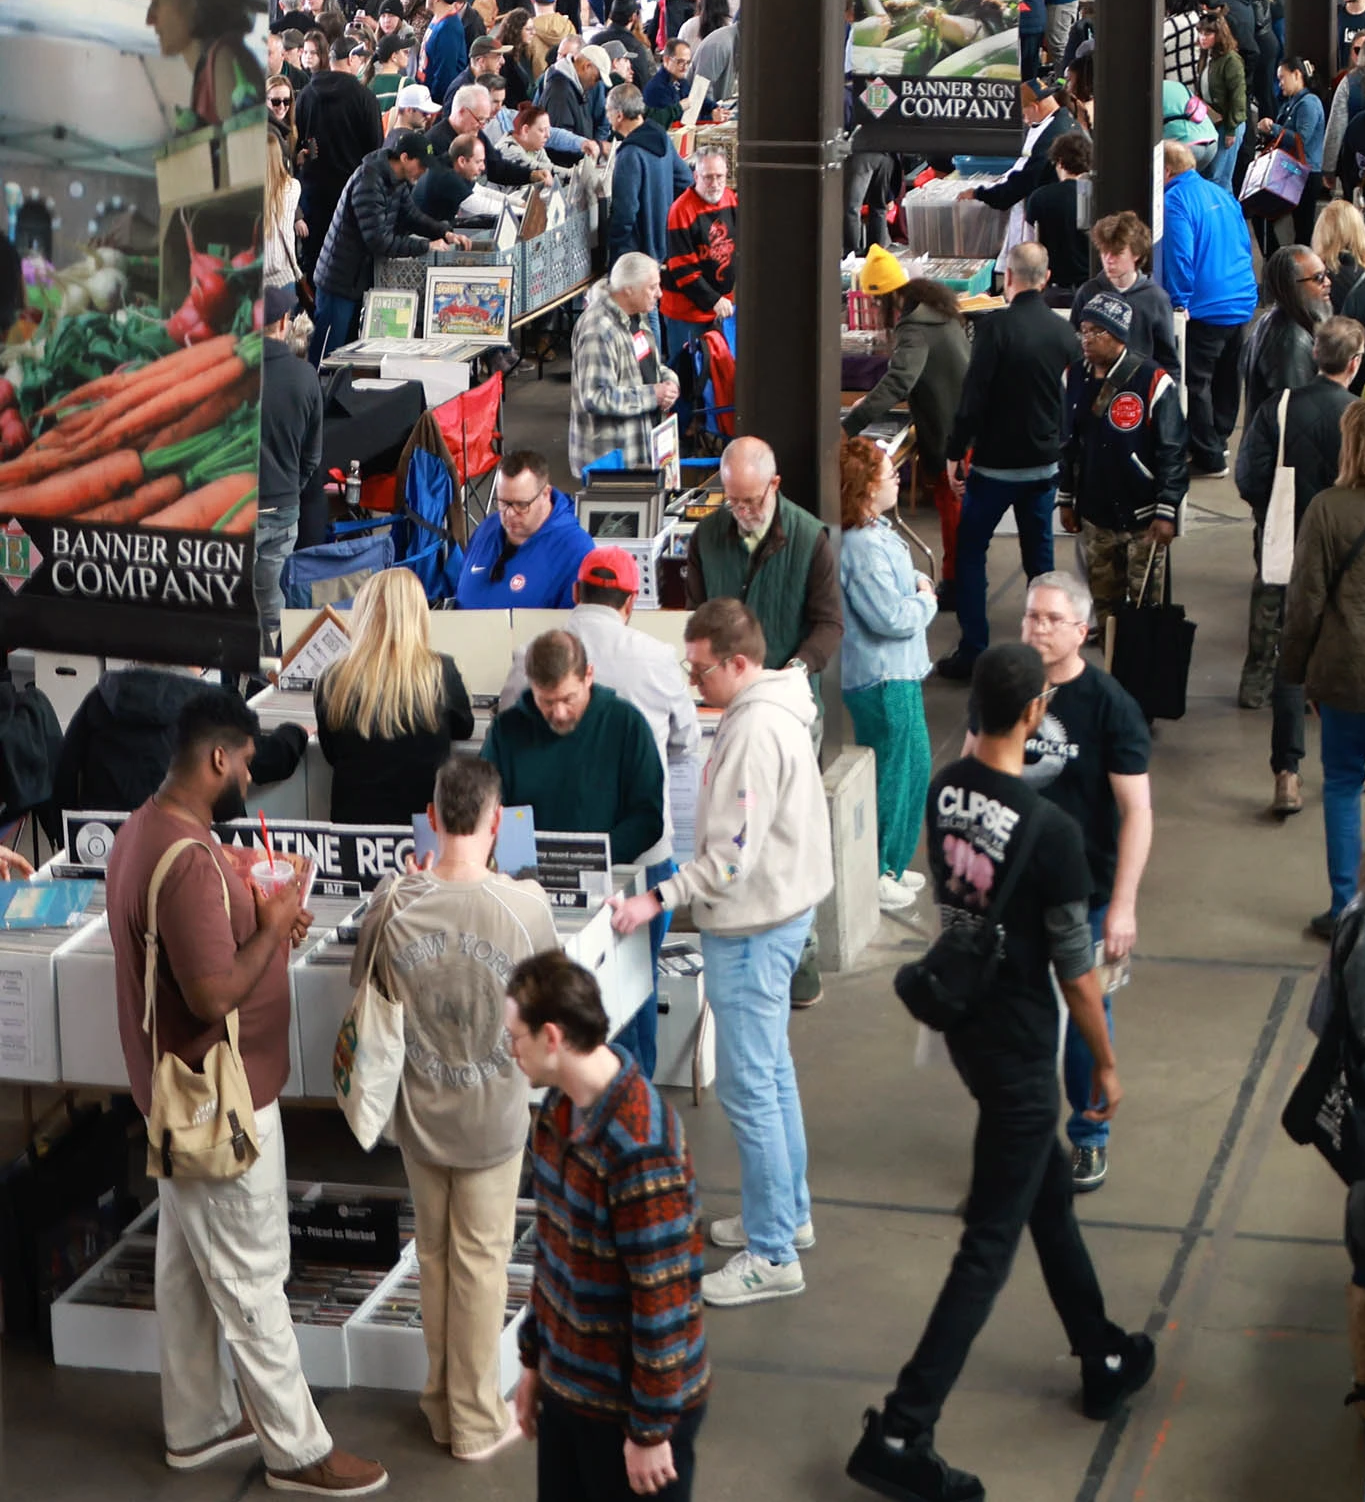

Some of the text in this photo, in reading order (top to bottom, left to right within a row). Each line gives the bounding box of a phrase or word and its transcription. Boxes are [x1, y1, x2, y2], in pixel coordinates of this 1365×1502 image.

[901, 80, 1016, 99] BANNER SIGN
[900, 97, 1016, 119] COMPANY
[52, 527, 245, 572] BANNER SIGN
[51, 559, 241, 606] COMPANY
[323, 883, 344, 895] JAZZ
